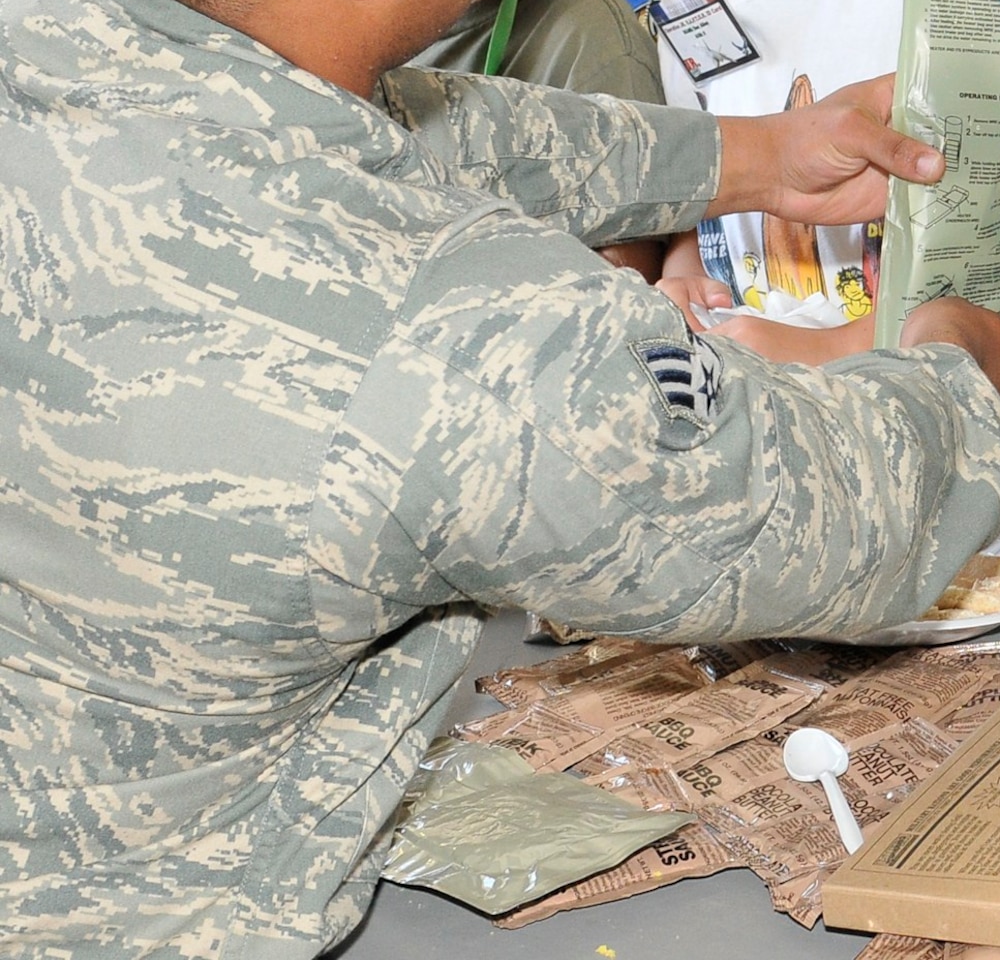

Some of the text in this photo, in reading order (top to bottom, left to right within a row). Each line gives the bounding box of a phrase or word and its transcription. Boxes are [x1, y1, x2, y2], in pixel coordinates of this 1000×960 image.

[959, 92, 997, 100] OPERATING
[874, 690, 915, 711] FREE
[659, 716, 695, 738] BBQ
